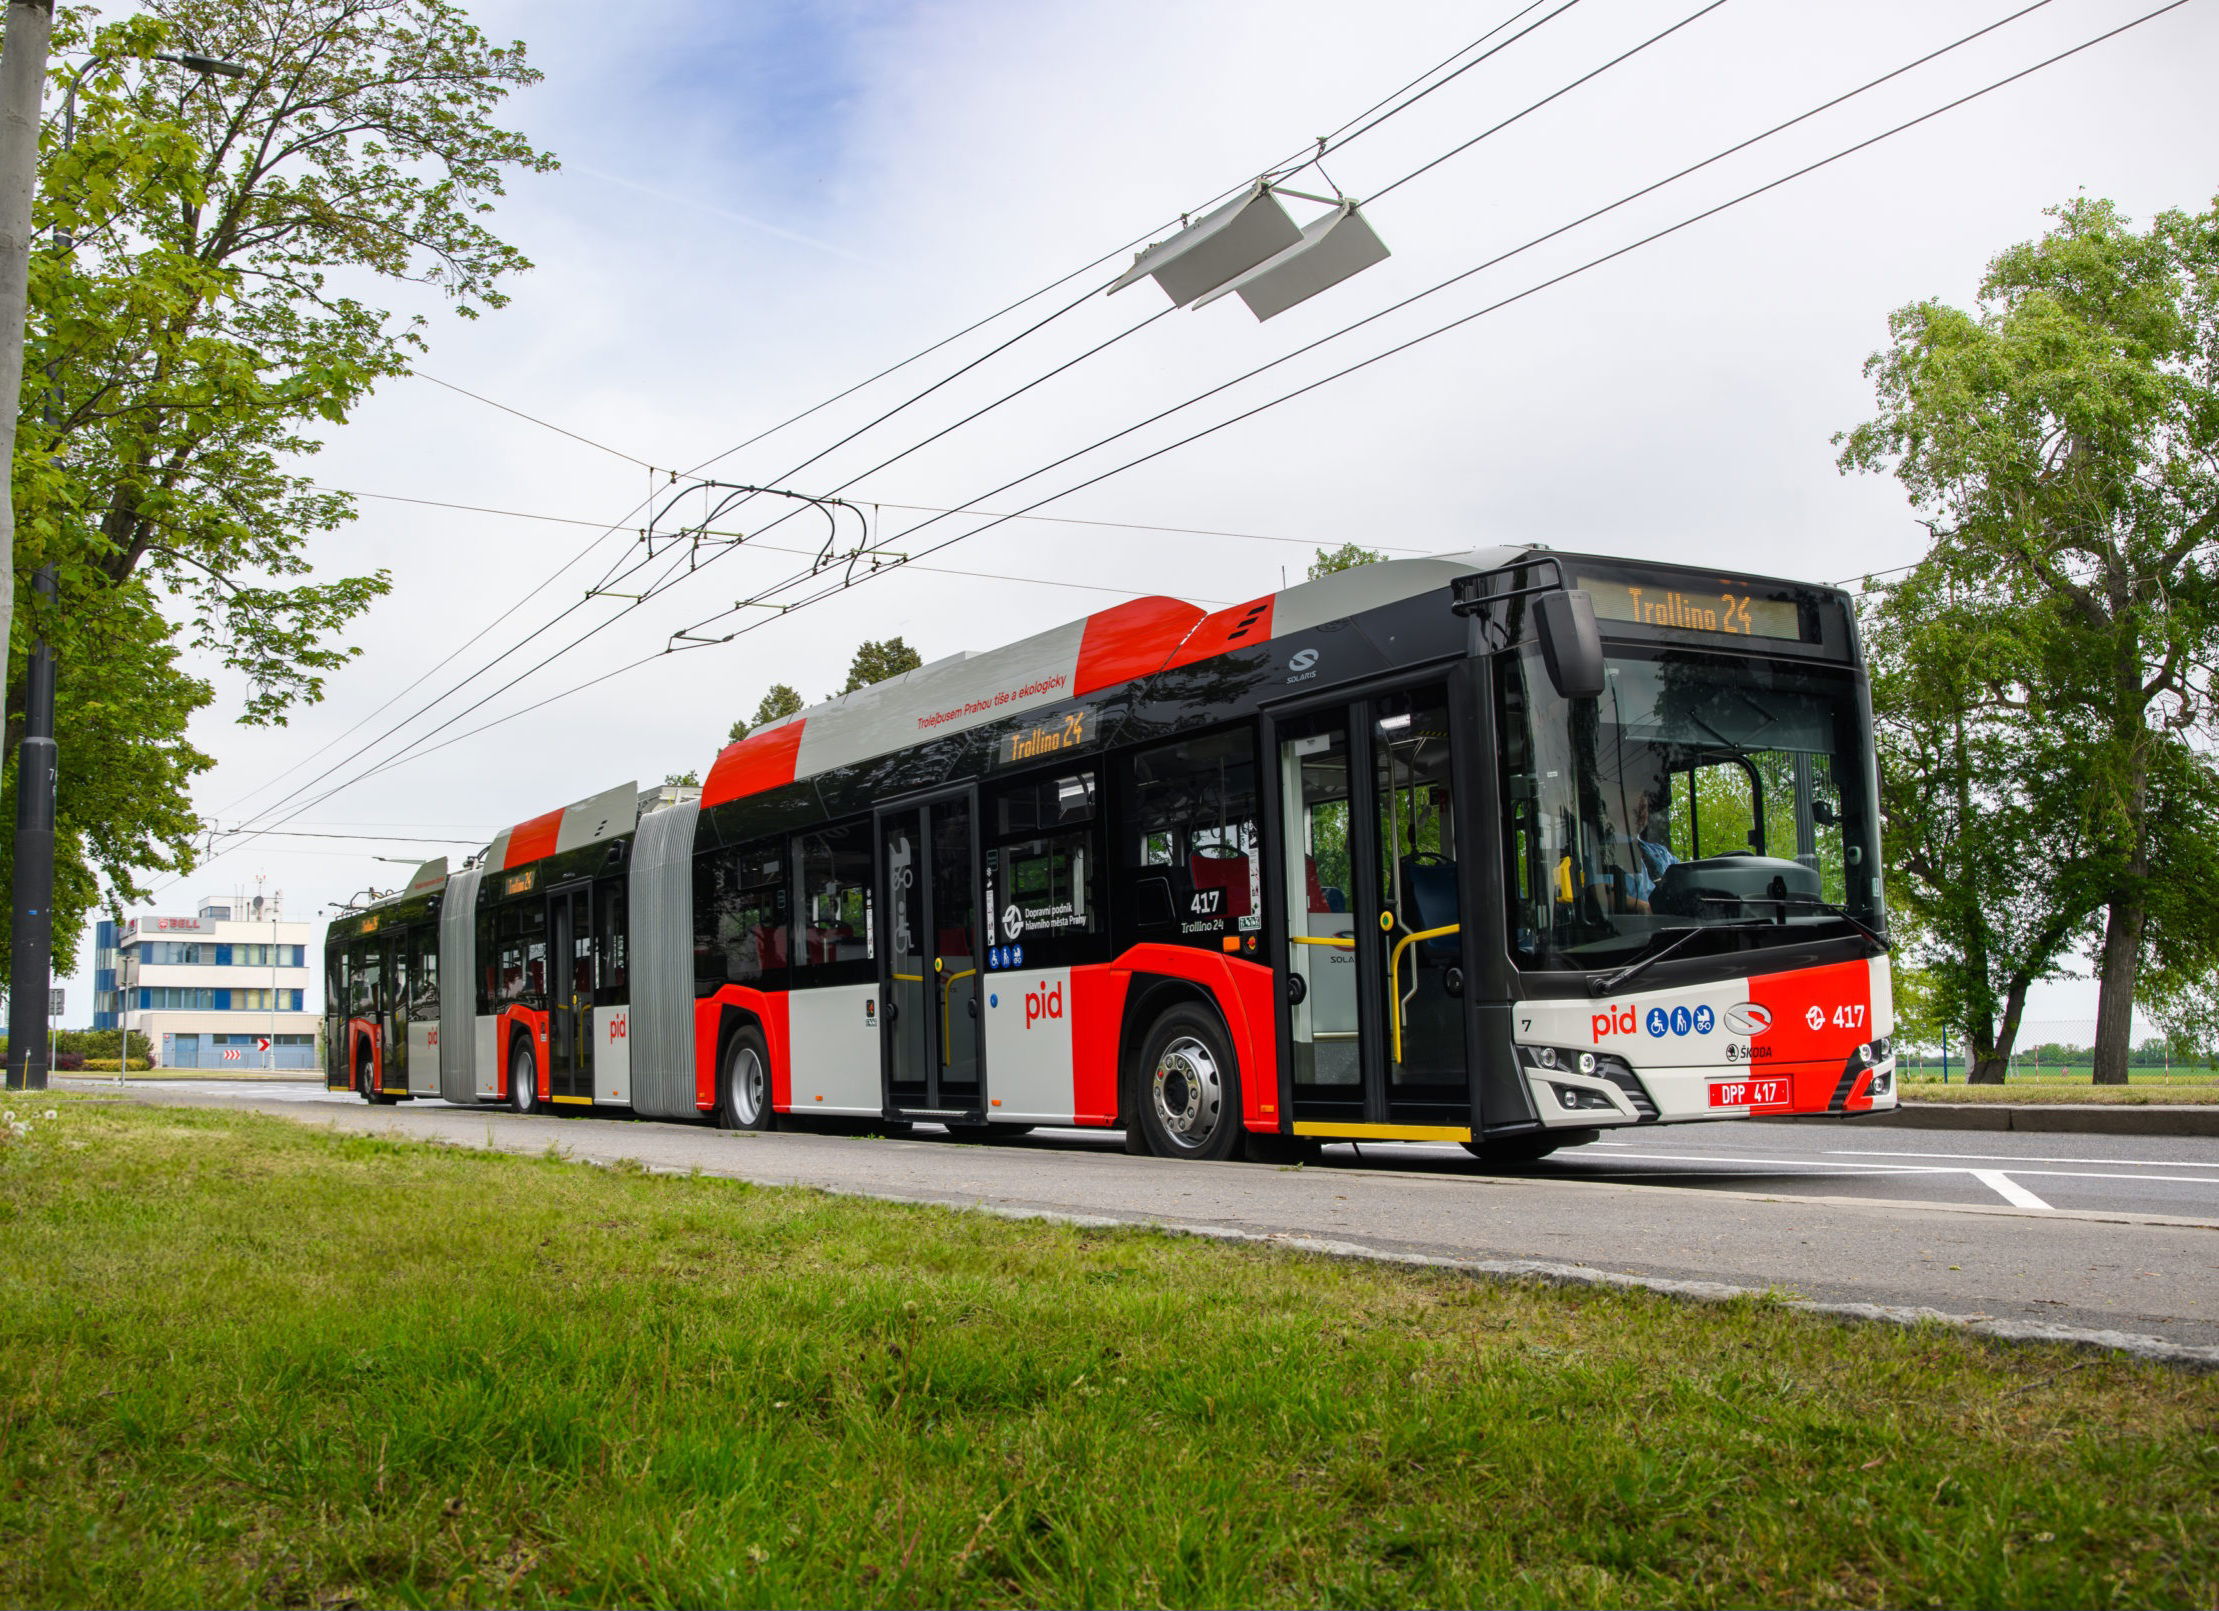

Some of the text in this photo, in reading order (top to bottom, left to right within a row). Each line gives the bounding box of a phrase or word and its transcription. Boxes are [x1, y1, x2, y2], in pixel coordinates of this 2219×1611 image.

[1627, 586, 1752, 635] Trollino 24
[1286, 671, 1317, 684] SOLARIS
[917, 674, 1067, 729] Trolejbusem Prahou tiše a ekologicky
[1011, 712, 1084, 760] Trollino 24
[1025, 906, 1050, 919] Dopravní
[1190, 891, 1219, 914] 417
[170, 919, 200, 929] BELL
[1025, 915, 1086, 931] hlavního města Prahy
[1181, 919, 1224, 933] Trollino 24
[1026, 980, 1063, 1030] pid
[1521, 1019, 1532, 1032] 7
[1591, 1004, 1637, 1044] pid
[1832, 1004, 1865, 1029] 417
[610, 1013, 626, 1045] pid
[1740, 1045, 1772, 1059] ŠKODA
[1721, 1083, 1777, 1105] DPP 417
